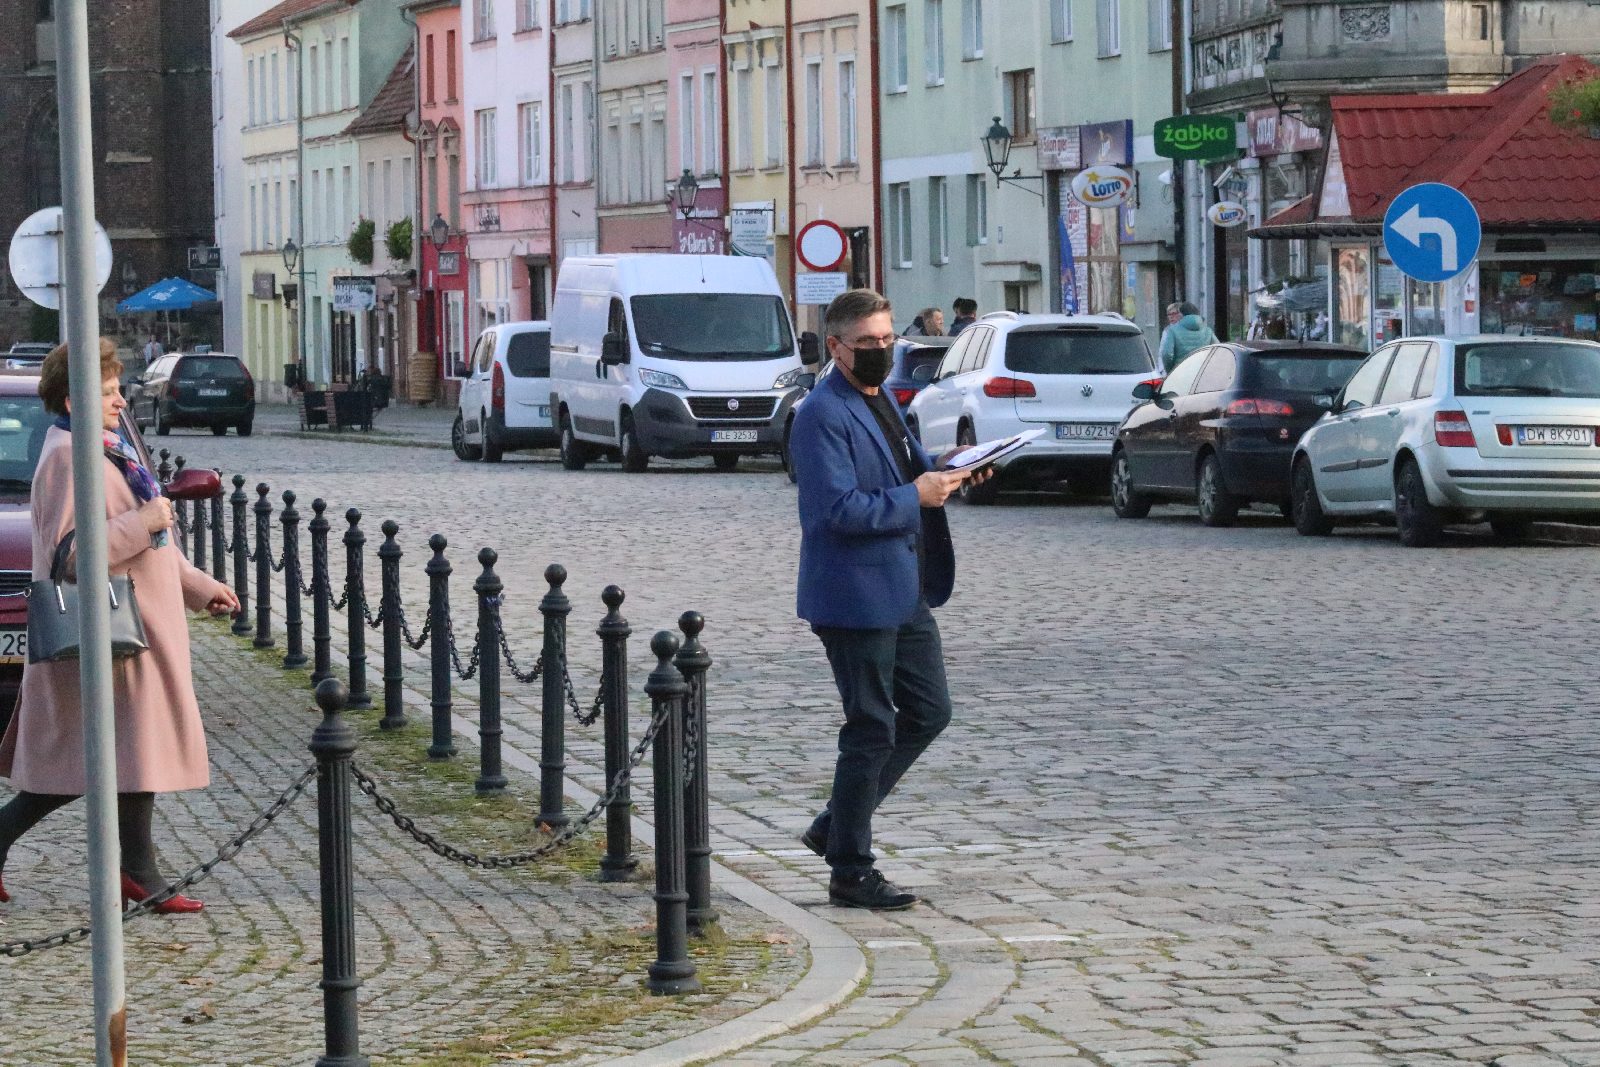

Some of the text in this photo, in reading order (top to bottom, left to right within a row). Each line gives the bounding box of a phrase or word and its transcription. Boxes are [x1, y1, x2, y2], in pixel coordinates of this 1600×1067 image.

[1163, 123, 1229, 143] żabka
[1091, 180, 1121, 197] LOTTO
[715, 431, 757, 440] DLE 32532
[1061, 424, 1116, 437] DLU 67214
[1526, 427, 1588, 441] DW 8K901
